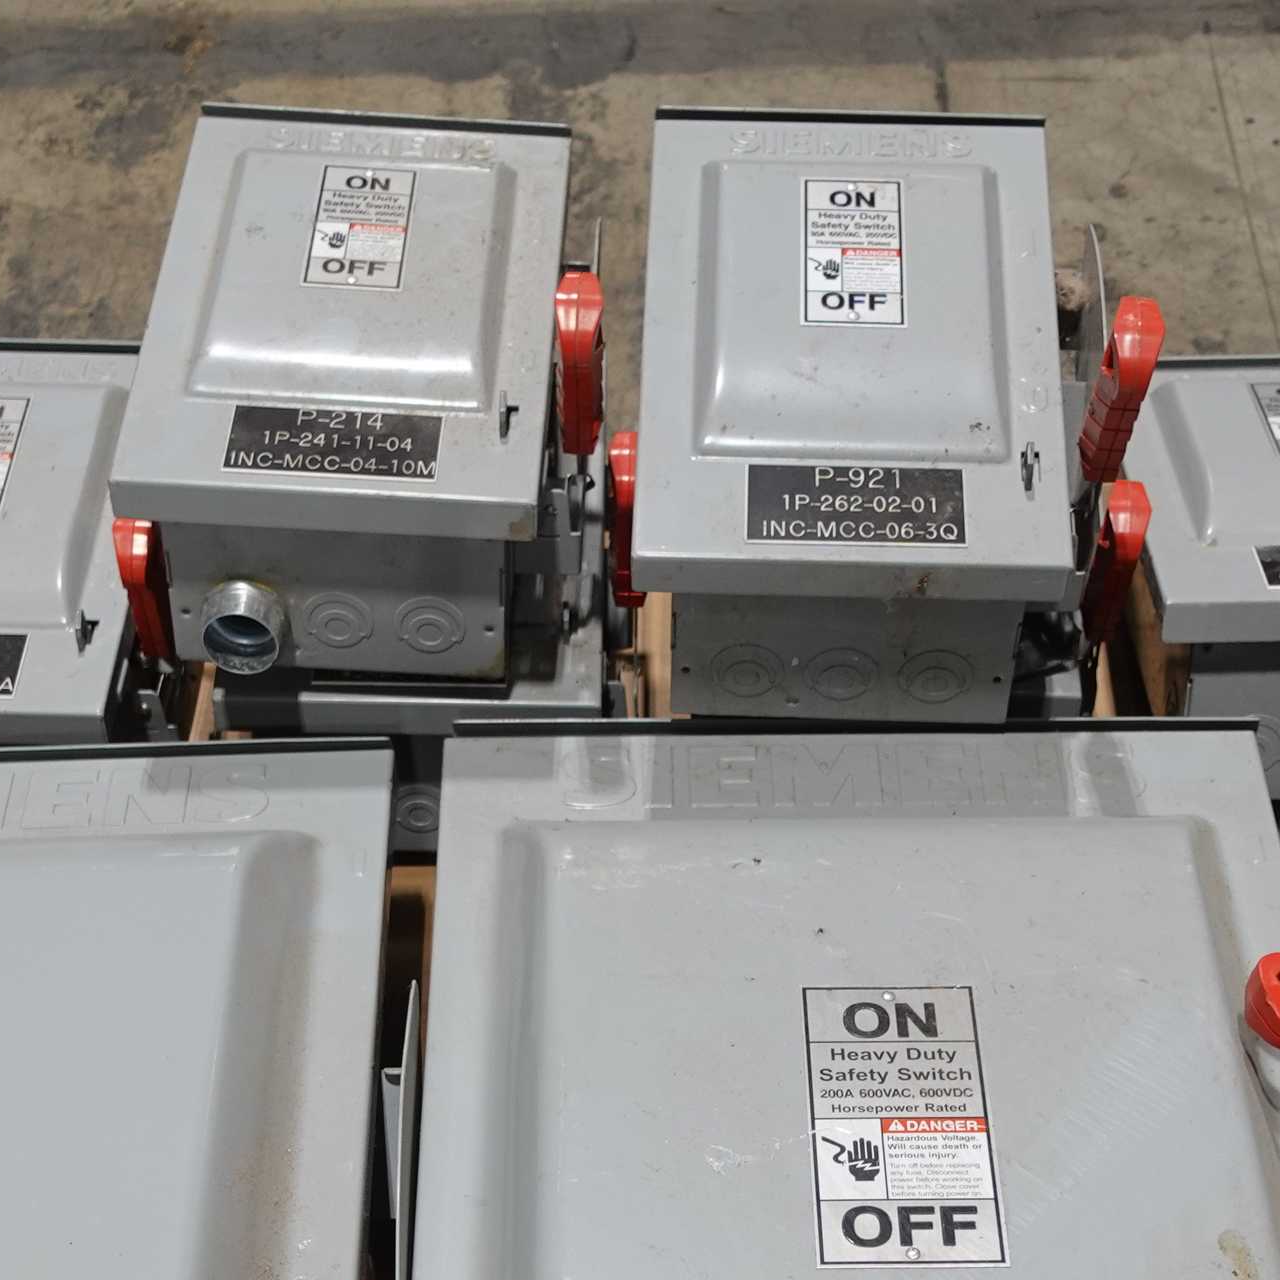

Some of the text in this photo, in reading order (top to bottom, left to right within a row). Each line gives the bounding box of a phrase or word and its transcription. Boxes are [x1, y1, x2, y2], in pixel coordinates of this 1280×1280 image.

[730, 128, 975, 159] SIEMENS
[345, 175, 391, 191] ON
[829, 190, 876, 208] ON
[811, 221, 896, 231] Safety Switch
[818, 211, 889, 222] Heavy Duty
[322, 257, 386, 277] OFF
[821, 292, 887, 312] OFF
[297, 410, 384, 430] P-214
[263, 430, 413, 452] 1P-241-11-04
[229, 450, 437, 476] INC-MCC-04-10M
[814, 466, 901, 489] P-921
[782, 493, 937, 513] 1P-262-02-01
[762, 520, 958, 540] INC-MCC-06-3Q
[563, 743, 1147, 810] SIEMENS
[842, 1002, 939, 1039] ON
[830, 1047, 957, 1064] Heavy Duty
[819, 1067, 972, 1084] Safety Switch
[820, 1087, 974, 1100] 200A 600VAC, 600VDC
[831, 1103, 967, 1116] Horsepower Rated
[907, 1120, 978, 1132] DANGER
[841, 1205, 978, 1248] OFF
